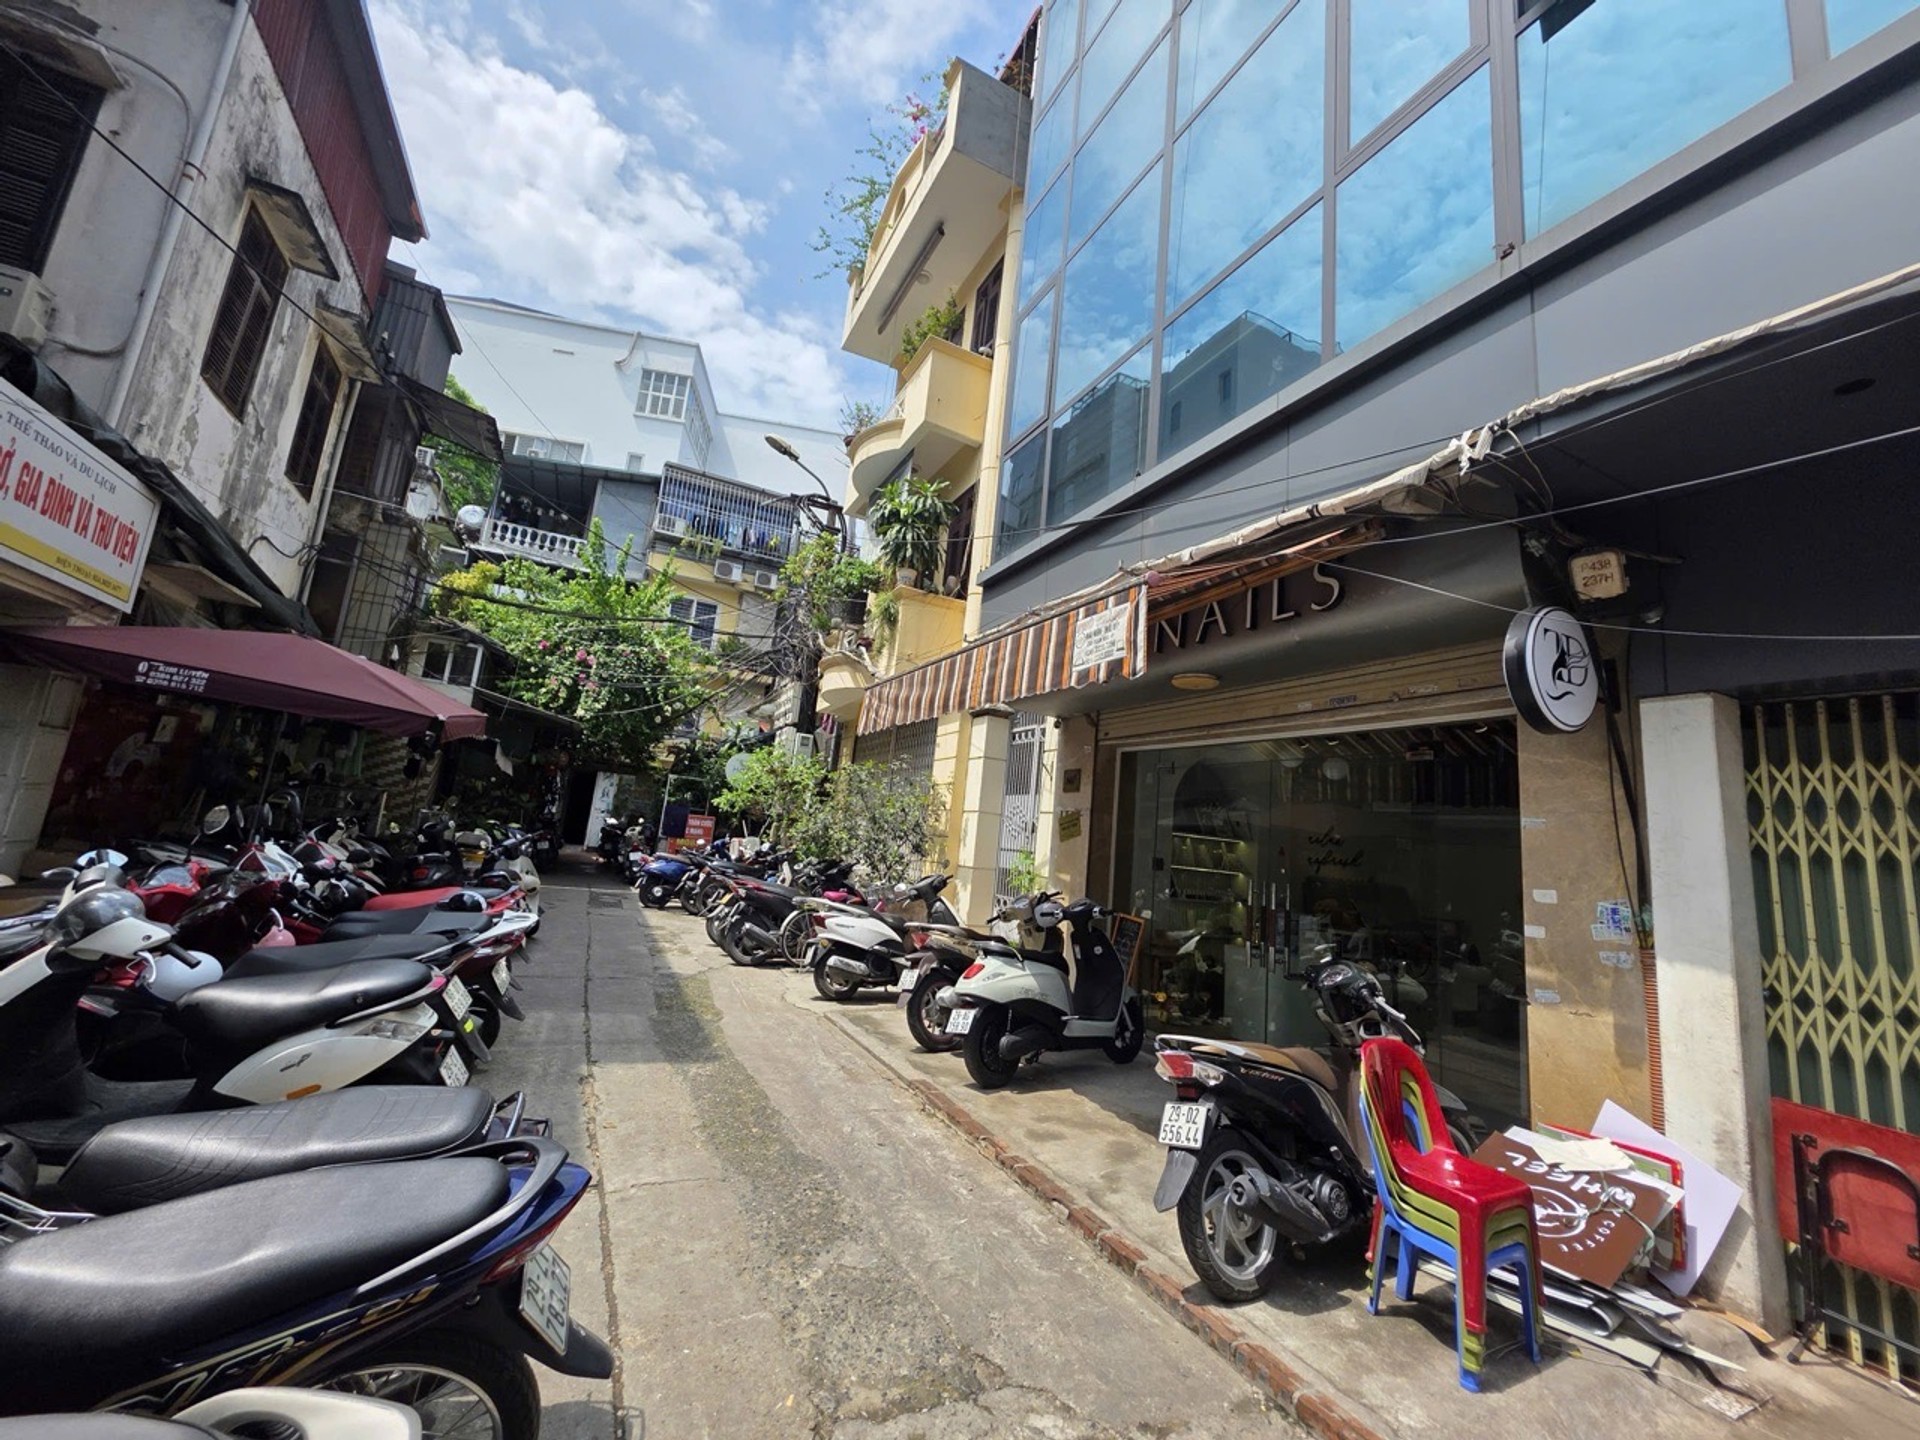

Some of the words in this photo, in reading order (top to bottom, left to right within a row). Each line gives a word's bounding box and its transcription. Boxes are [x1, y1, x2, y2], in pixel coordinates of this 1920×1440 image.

[33, 429, 63, 458] THAO
[79, 461, 95, 478] DU
[94, 471, 117, 495] LỊCH
[14, 461, 44, 510] GIA
[40, 473, 78, 528] ĐÌNH
[74, 493, 95, 538] VÀ
[90, 507, 118, 550] THƯ
[113, 519, 141, 568] VIỆN
[1154, 563, 1341, 653] NAILS
[1160, 1123, 1200, 1146] 556.44
